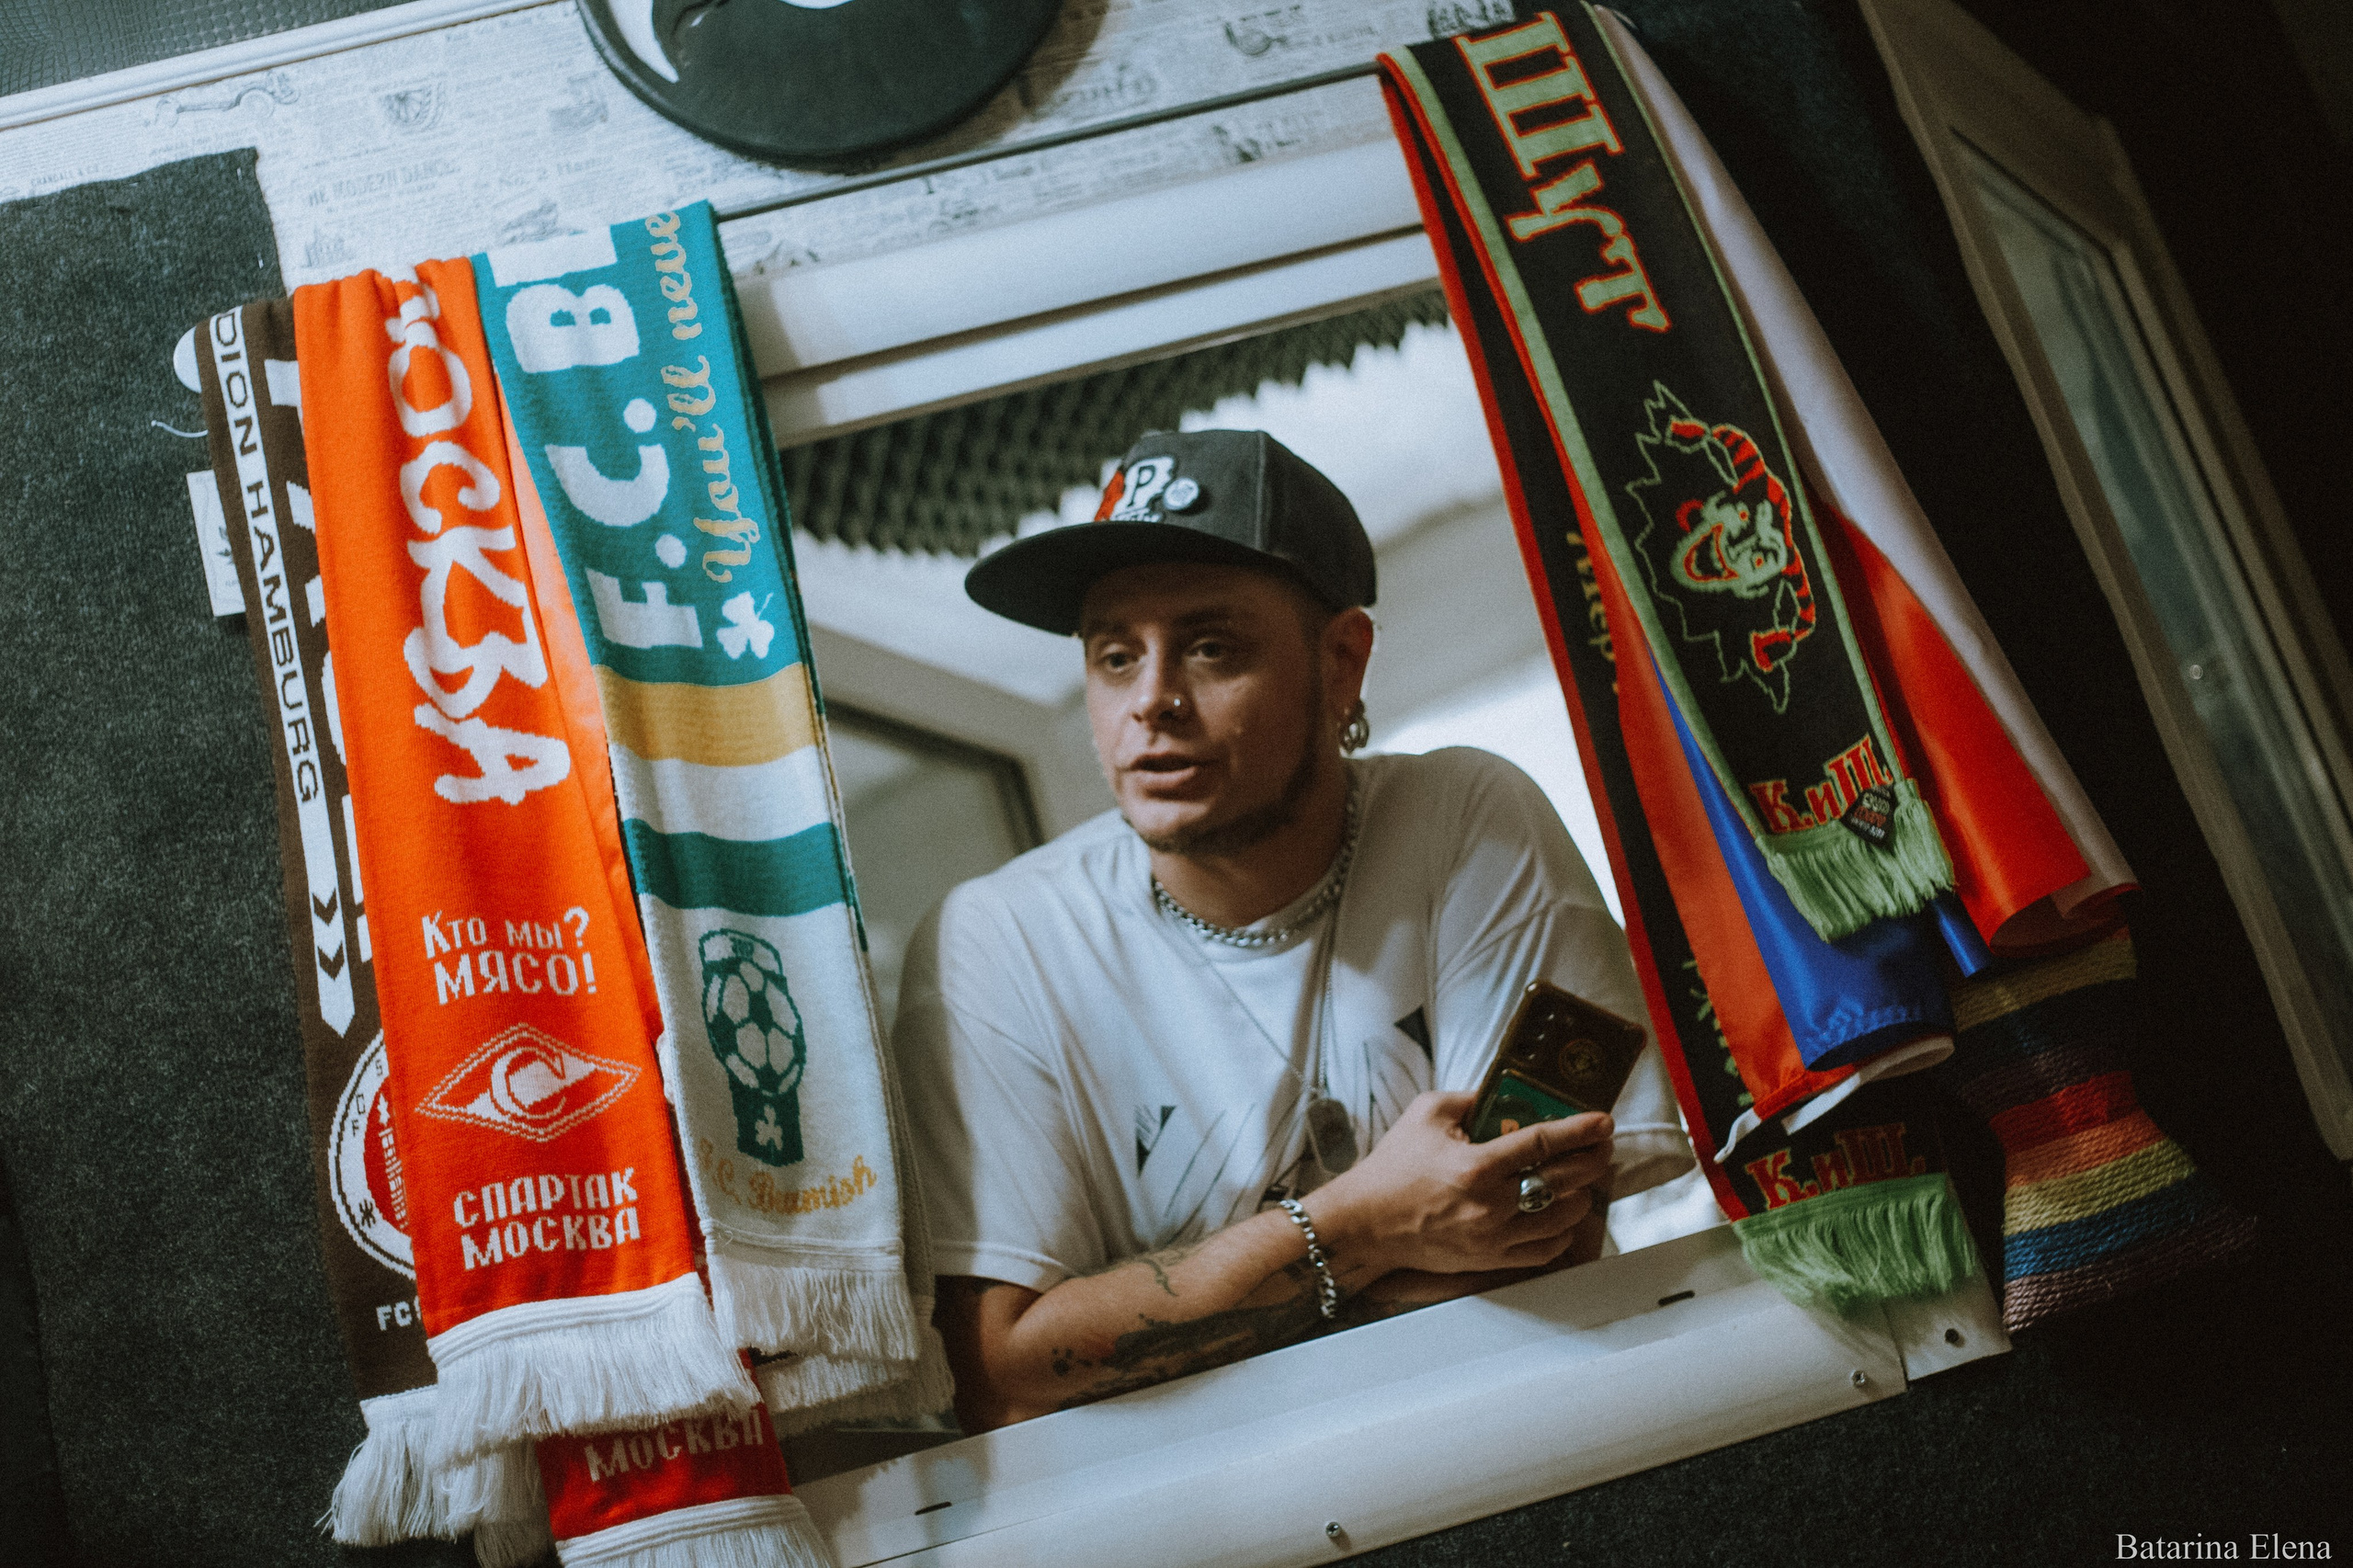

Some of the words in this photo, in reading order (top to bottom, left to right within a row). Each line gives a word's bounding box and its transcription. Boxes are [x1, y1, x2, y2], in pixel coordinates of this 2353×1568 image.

[1452, 10, 1672, 333] Шут
[246, 479, 319, 803] HAMBURG
[434, 951, 597, 1006] МЯСО!
[453, 1166, 639, 1229] СПАРТАК
[461, 1207, 641, 1272] МОСКВА
[376, 1301, 413, 1332] FC
